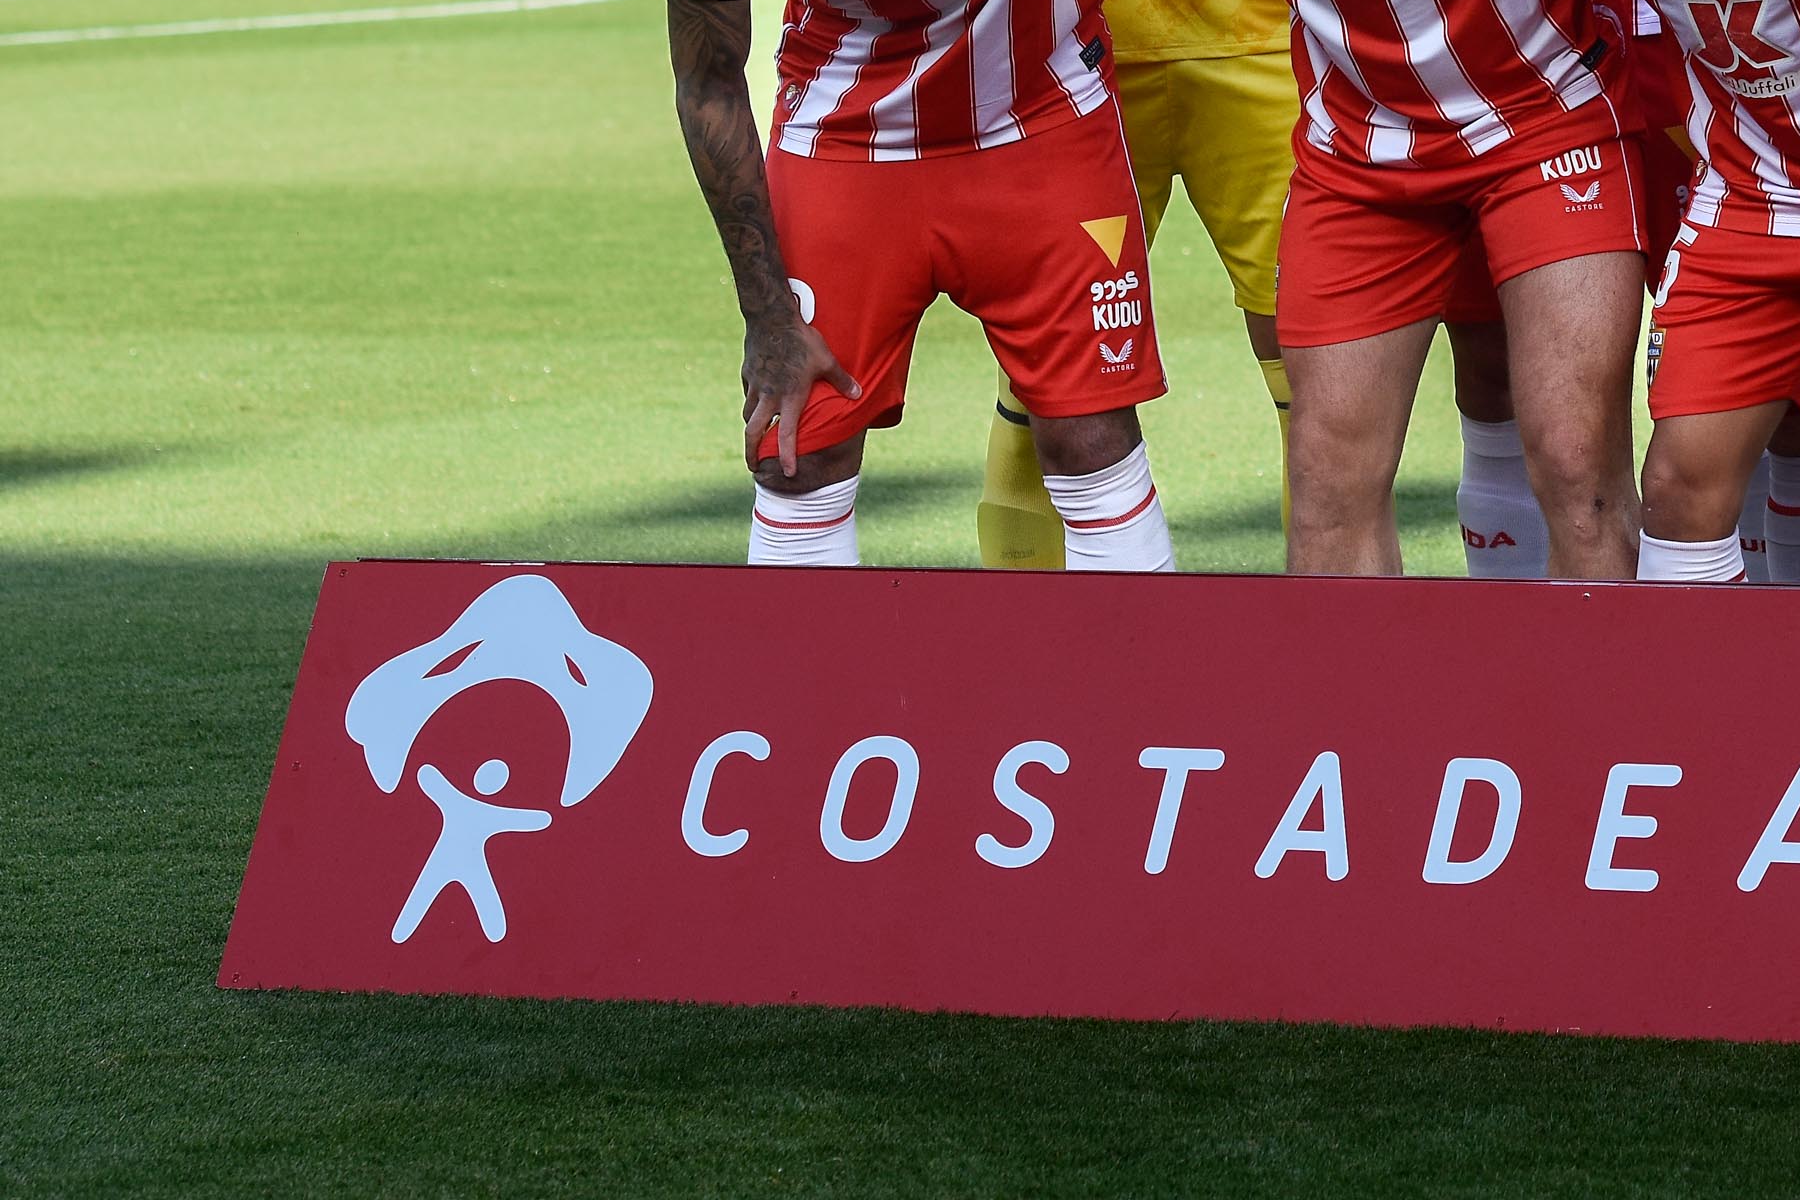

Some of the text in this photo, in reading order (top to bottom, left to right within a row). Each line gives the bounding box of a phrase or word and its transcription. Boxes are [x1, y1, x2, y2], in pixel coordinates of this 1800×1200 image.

[1741, 75, 1795, 96] Juffali
[1540, 146, 1602, 181] KUDU
[1565, 203, 1604, 213] CASTORE
[1091, 271, 1139, 302] كودو
[1092, 300, 1142, 331] KUDU
[1101, 363, 1136, 374] CASTORE
